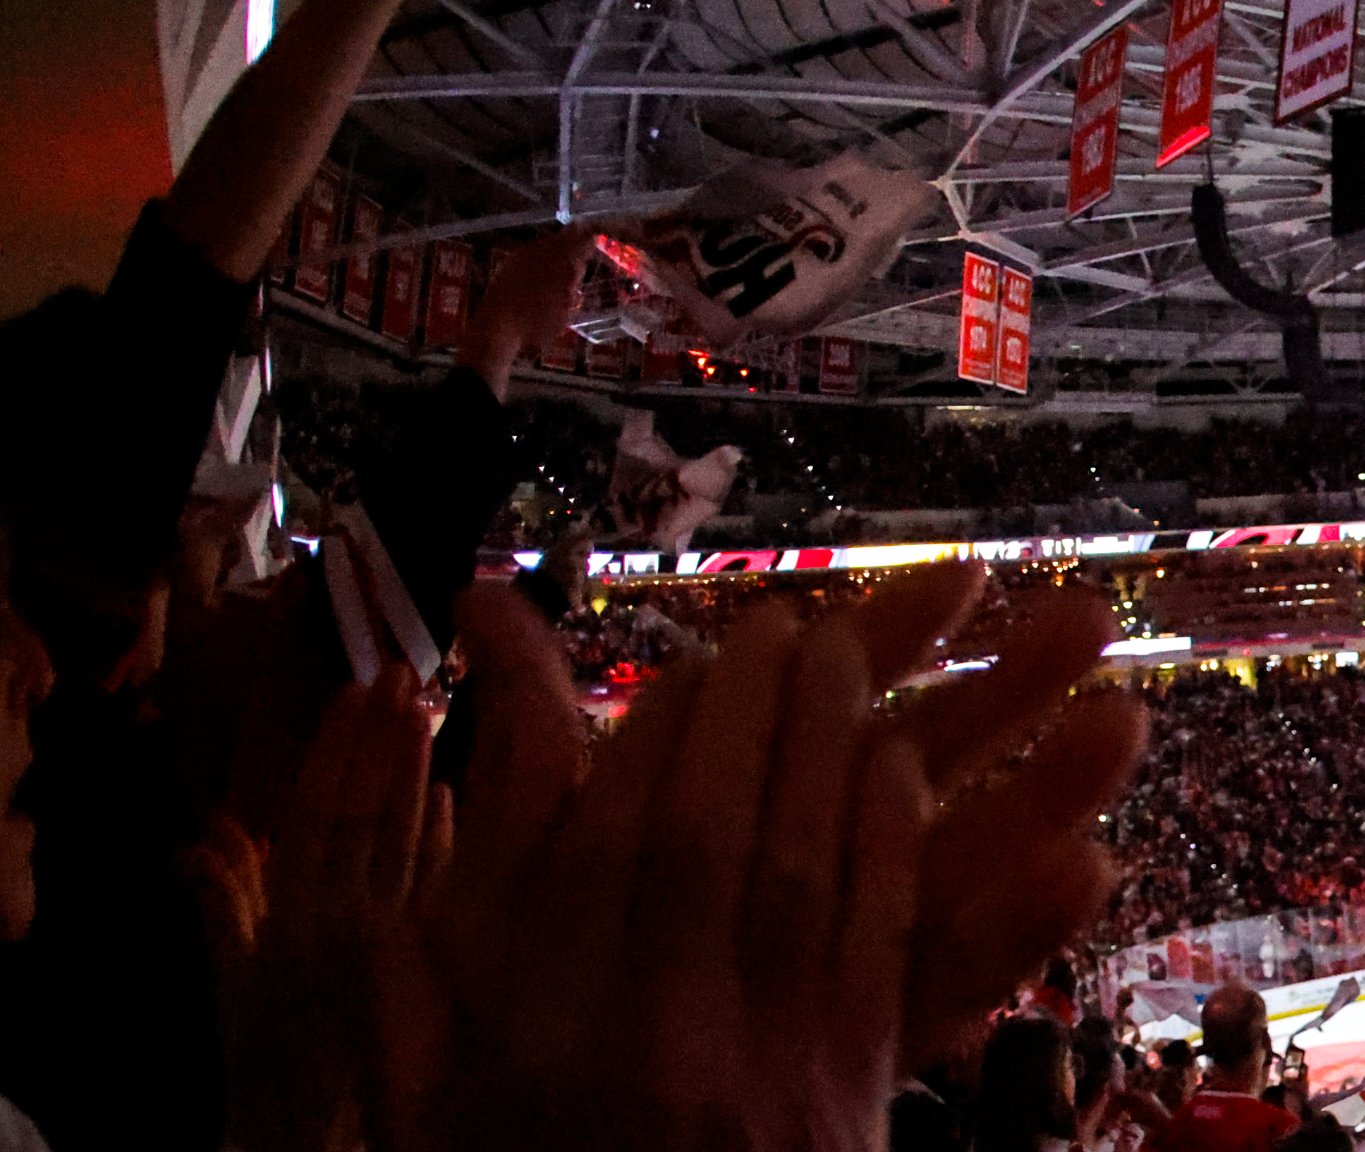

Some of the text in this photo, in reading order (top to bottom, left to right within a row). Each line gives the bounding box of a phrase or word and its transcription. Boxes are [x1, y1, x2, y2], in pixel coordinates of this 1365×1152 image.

[1292, 4, 1345, 54] NATIONAL
[1283, 43, 1348, 99] CHAMPIONS
[972, 263, 992, 295] ACC
